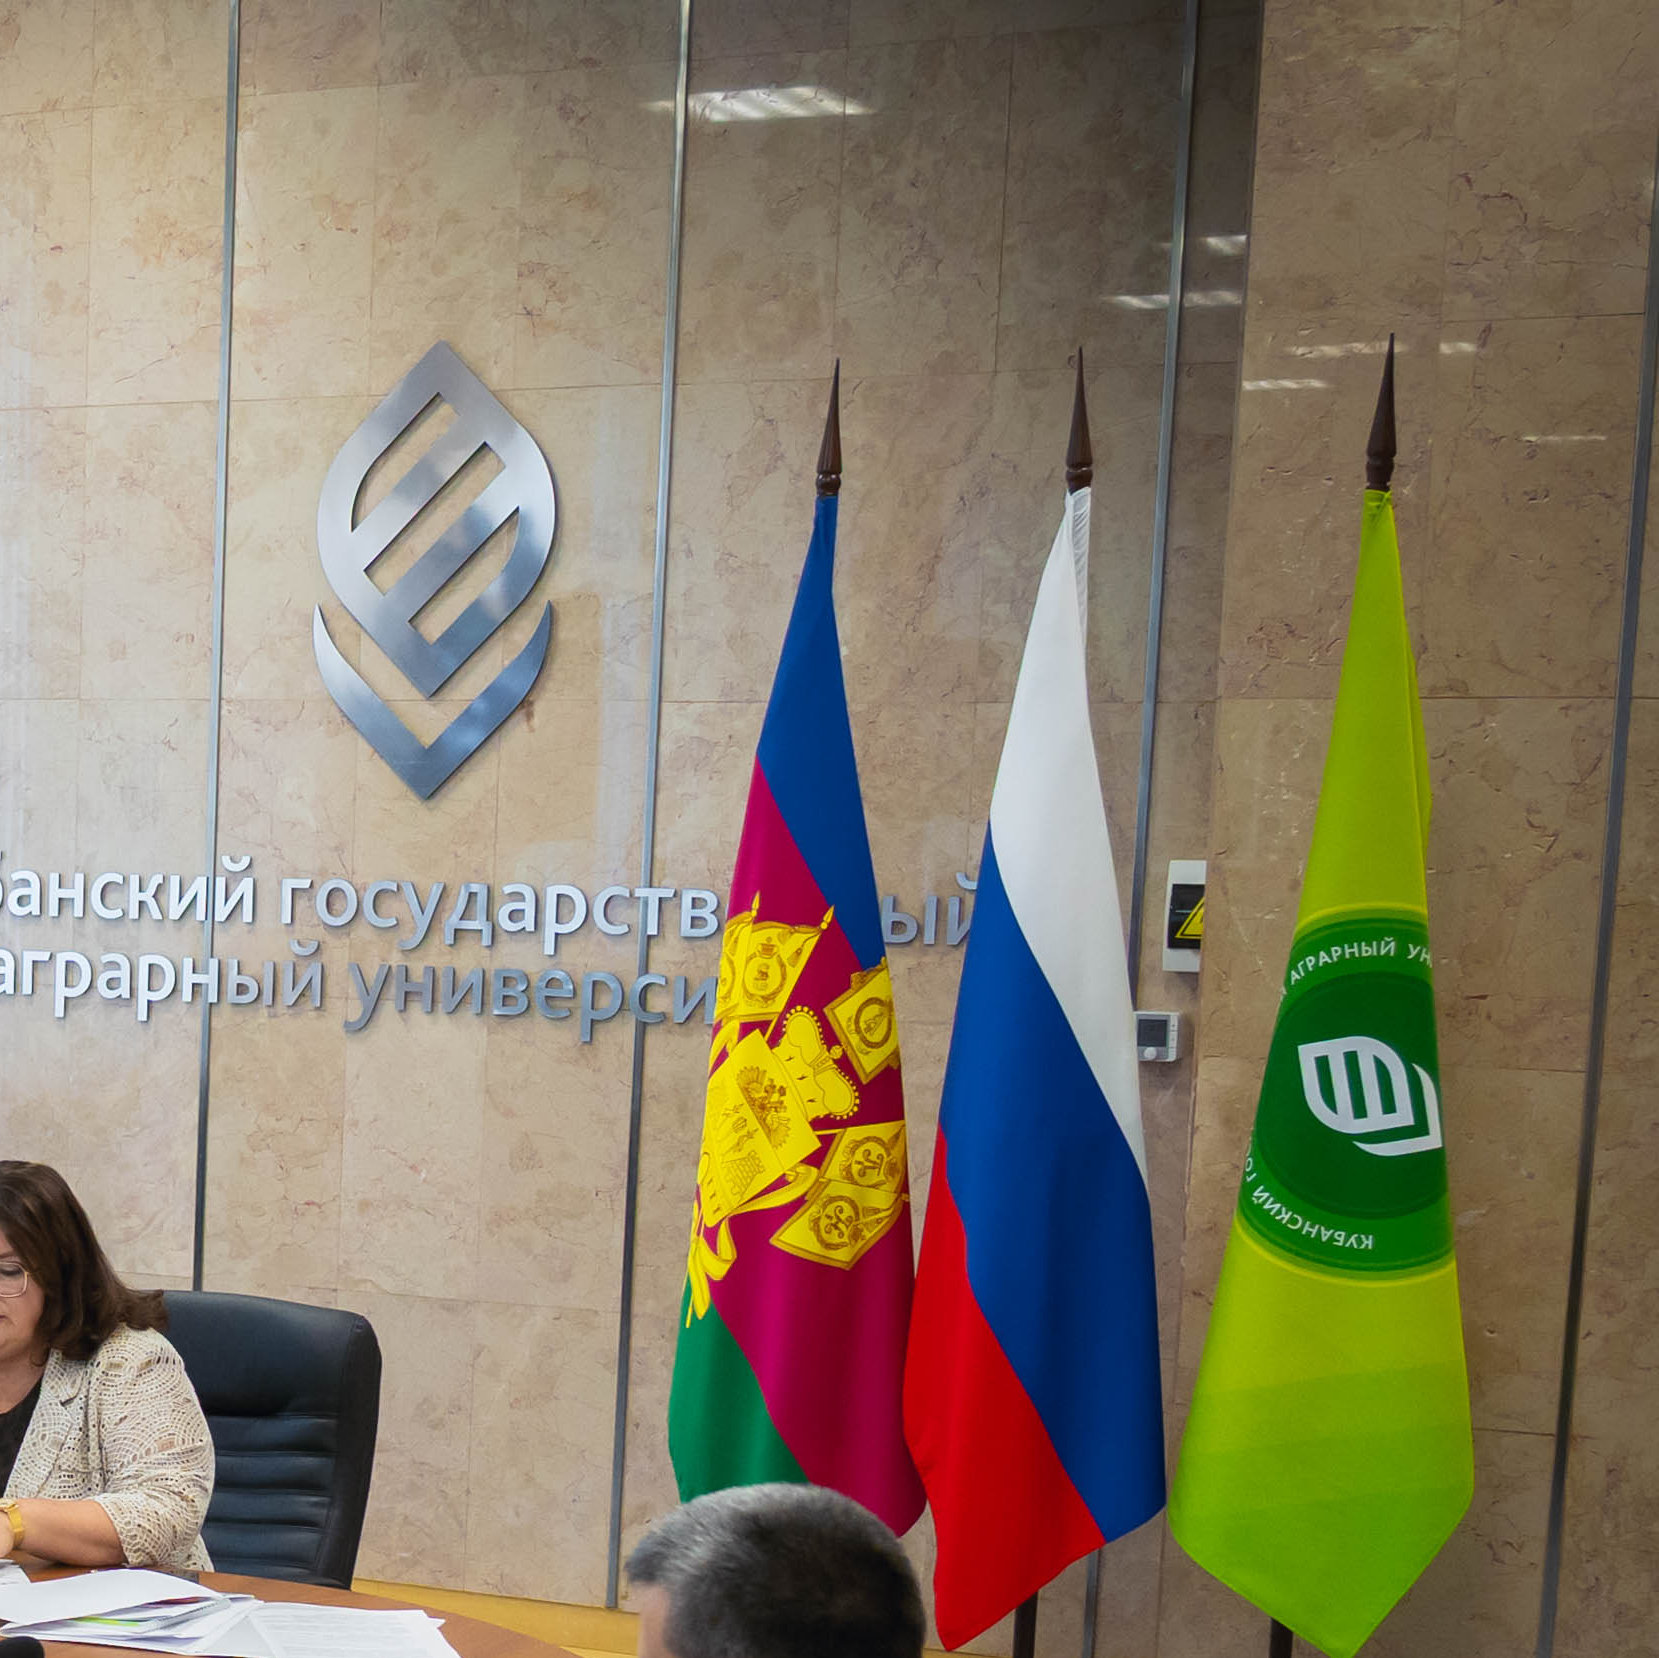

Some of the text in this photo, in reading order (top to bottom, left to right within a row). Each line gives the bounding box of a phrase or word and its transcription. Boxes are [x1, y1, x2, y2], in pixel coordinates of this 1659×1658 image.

[1289, 936, 1433, 986] АГРАРНЫЙ УН
[343, 961, 719, 1044] универси
[1251, 1184, 1375, 1250] КУБАНСКИЙ
